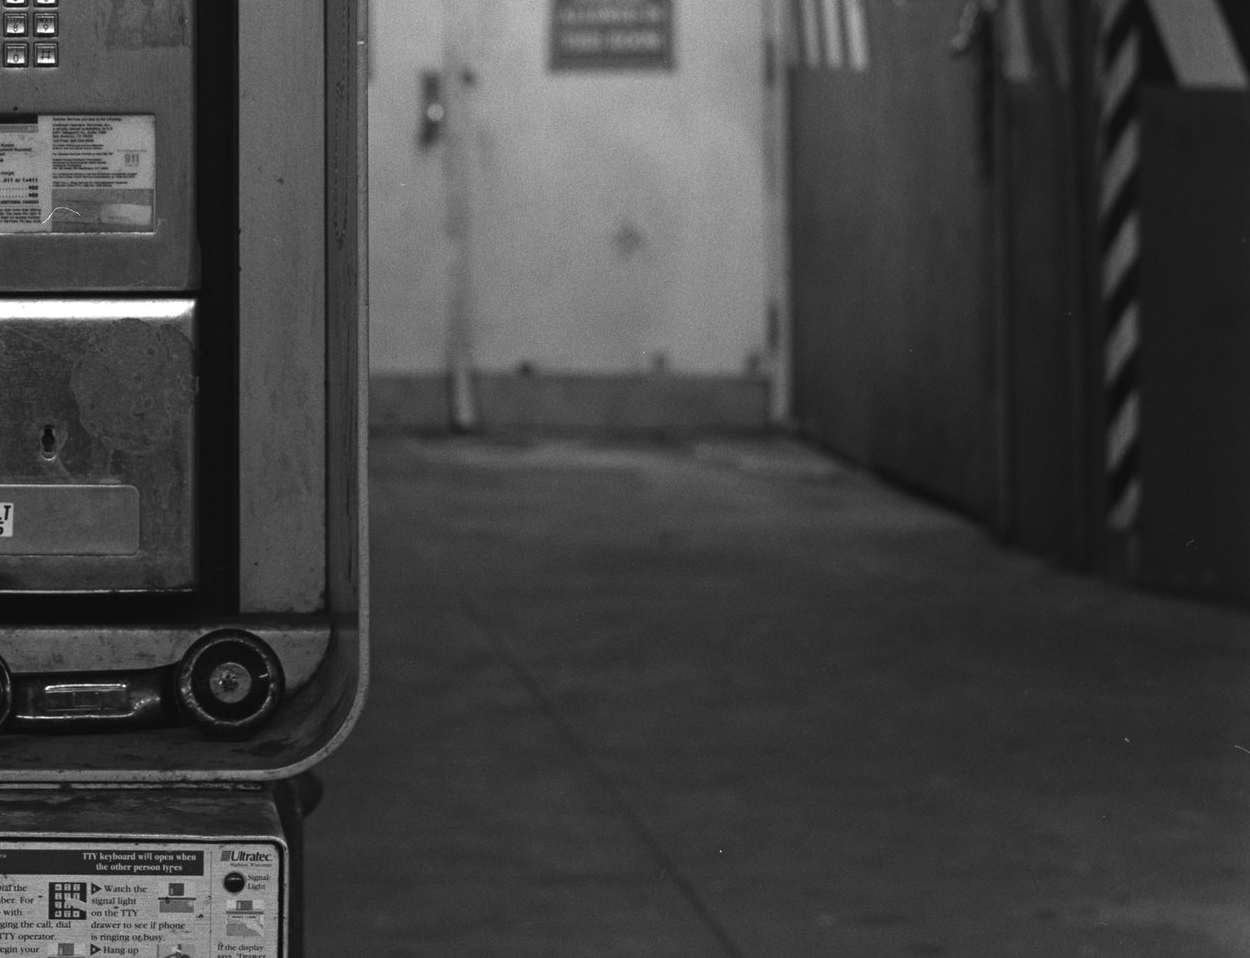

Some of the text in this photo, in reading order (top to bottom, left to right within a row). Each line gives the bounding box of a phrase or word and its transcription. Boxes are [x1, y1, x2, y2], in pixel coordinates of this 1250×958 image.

[13, 23, 19, 33] 8
[43, 23, 49, 32] 9
[13, 53, 19, 63] 0
[82, 852, 197, 862] TTY keyboard will open when
[230, 850, 272, 862] Ultratec
[96, 863, 183, 873] the other person types
[14, 884, 28, 892] the
[104, 884, 148, 893] Watch the
[247, 883, 266, 891] Light
[20, 896, 34, 904] For
[91, 897, 136, 906] signal light
[3, 908, 22, 916] with
[104, 909, 118, 917] the
[120, 909, 138, 917] TTY
[36, 920, 54, 929] call,
[56, 920, 71, 928] dial
[91, 921, 121, 929] drawer
[150, 921, 156, 929] if
[158, 921, 185, 931] phone
[18, 933, 56, 942] operator.
[100, 934, 130, 942] ringing
[143, 934, 165, 943] busy.
[20, 947, 40, 955] your
[103, 946, 139, 956] Hang up
[238, 944, 263, 952] display
